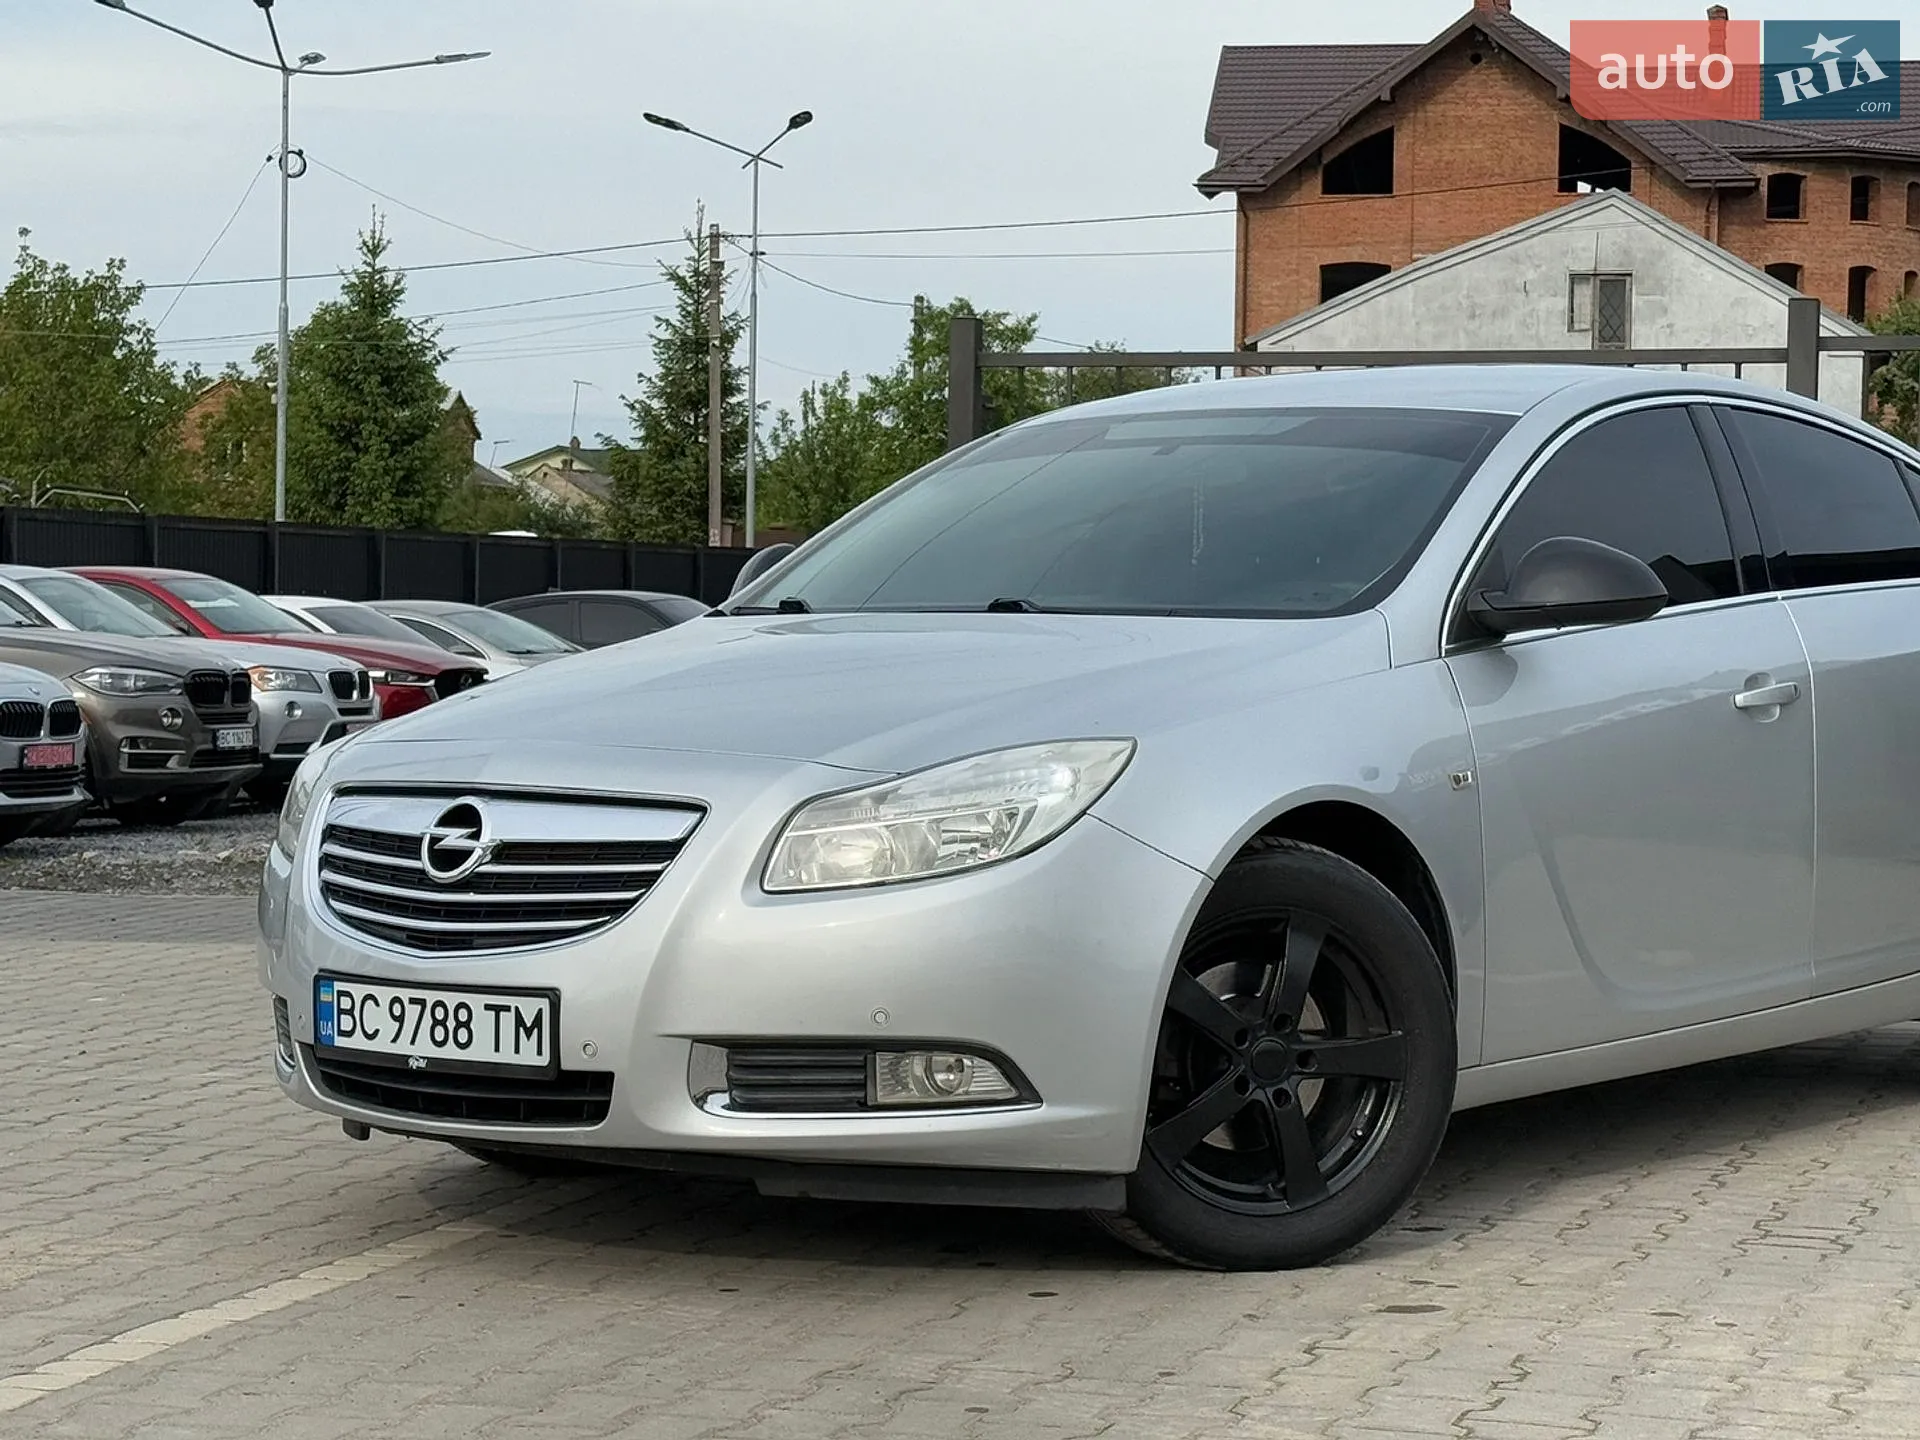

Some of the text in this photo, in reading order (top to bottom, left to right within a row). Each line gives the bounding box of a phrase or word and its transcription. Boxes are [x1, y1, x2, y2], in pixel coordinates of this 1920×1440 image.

[319, 1020, 333, 1037] UA
[336, 989, 544, 1057] BC 9788 TM
